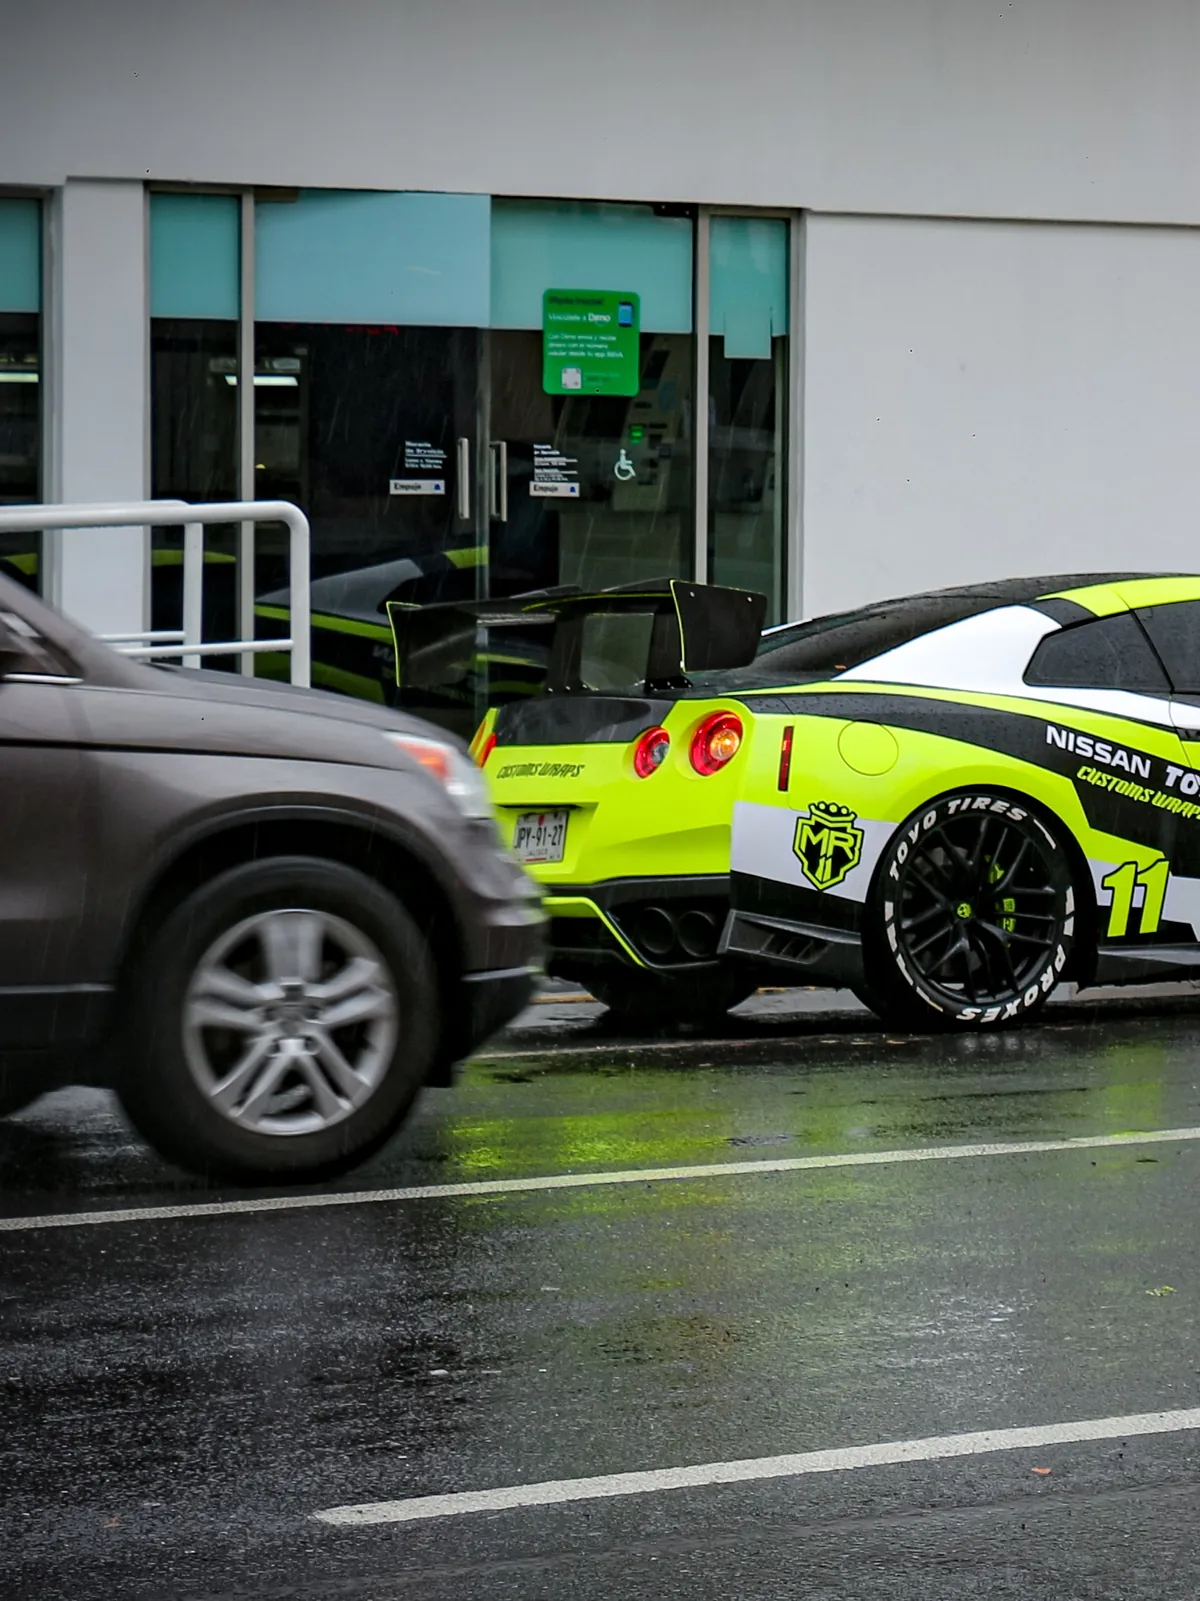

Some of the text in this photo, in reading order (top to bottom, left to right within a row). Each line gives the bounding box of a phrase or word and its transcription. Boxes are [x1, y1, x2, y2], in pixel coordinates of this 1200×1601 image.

[1046, 725, 1151, 779] NISSAN
[948, 797, 1028, 822] TIRES
[800, 825, 854, 881] MR
[889, 810, 938, 882] TOYO
[1101, 859, 1170, 937] 11
[956, 944, 1066, 1023] PROXES
